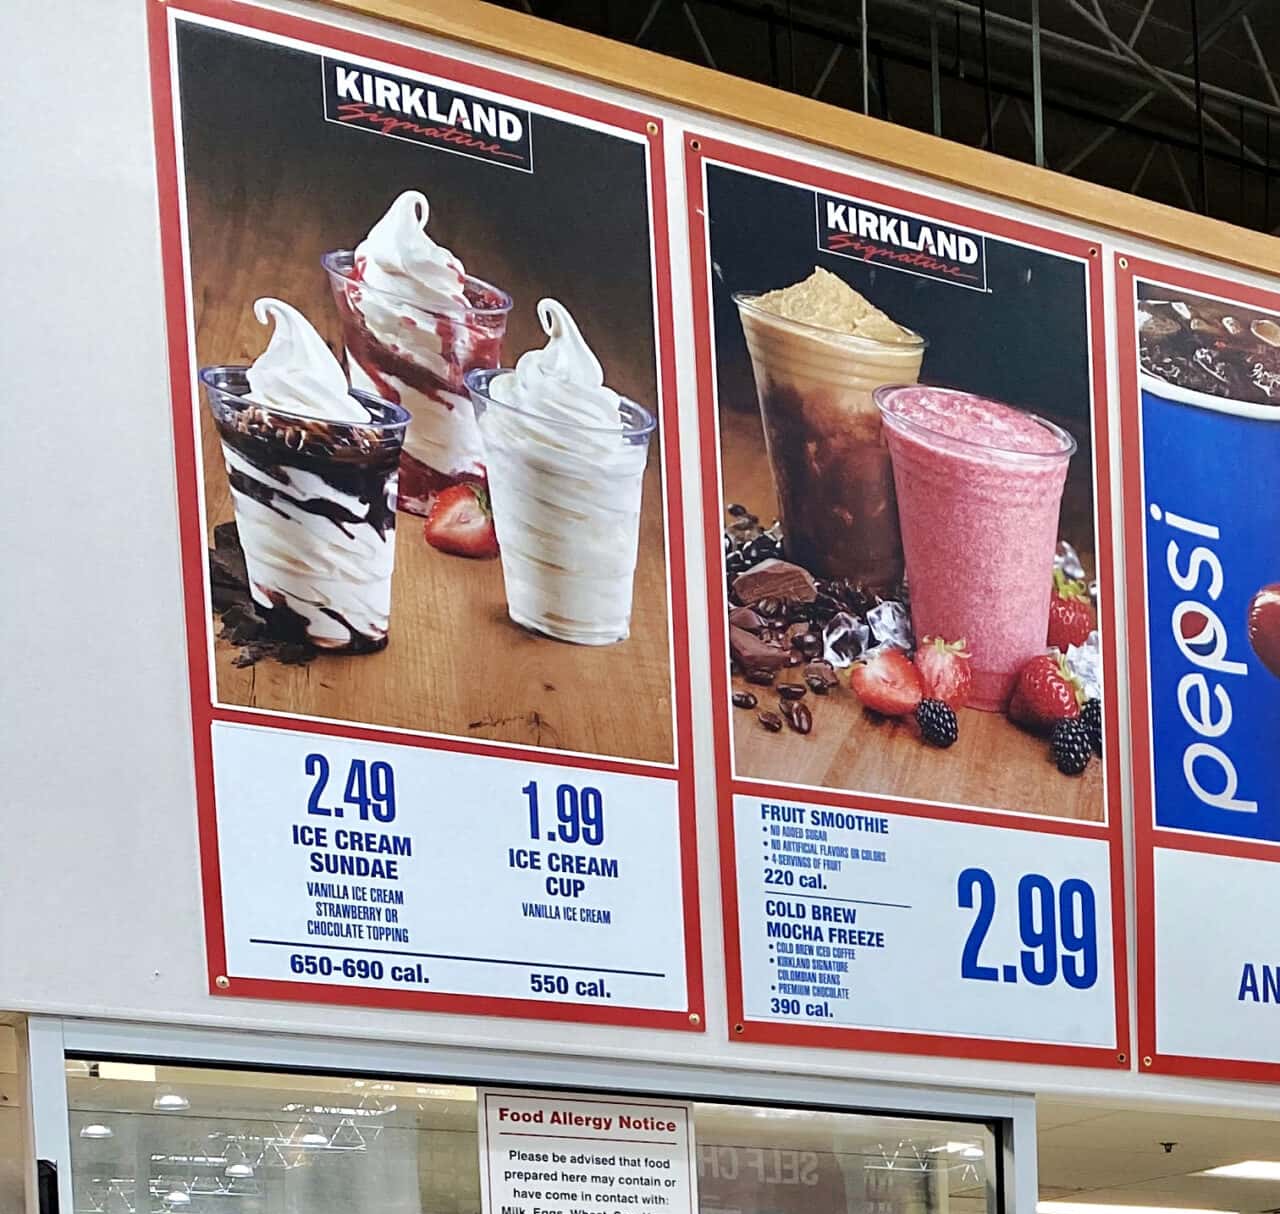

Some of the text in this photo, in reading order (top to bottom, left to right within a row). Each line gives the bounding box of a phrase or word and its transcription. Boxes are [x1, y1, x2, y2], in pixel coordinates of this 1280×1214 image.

[336, 66, 523, 142] KIRKLAND
[337, 103, 524, 159] Signature
[826, 200, 978, 264] KIRKLAND
[828, 233, 979, 281] Signature
[1149, 503, 1258, 814] pepsi
[305, 753, 397, 823] 2.49
[522, 781, 604, 846] 1.99
[761, 804, 889, 834] FRUIT SMOOTHIE
[292, 825, 412, 857] ICE CREAM
[820, 844, 848, 858] FLAVORS
[310, 853, 398, 880] SUNDAE
[508, 848, 619, 878] ICE CREAM
[545, 875, 585, 898] CUP
[764, 868, 827, 890] 220 cal.
[307, 882, 404, 905] VANILLA ICE CREAM
[316, 902, 398, 924] STRAWBERRY OR
[522, 902, 611, 925] VANILLA ICE CREAM
[766, 900, 856, 924] COLD BREW
[307, 921, 409, 944] CHOCOLATE TOPPING
[767, 921, 885, 948] MOCHA FREEZE
[957, 867, 1098, 989] 2.99
[776, 942, 856, 960] COLD BREW ICED COFFEE
[290, 954, 430, 984] 650-690 cal.
[777, 956, 848, 972] KIRKLAND SIGNATURE
[530, 974, 611, 998] 550 cal.
[771, 998, 833, 1018] 390 cal.
[499, 1107, 677, 1133] Food Allergy Notice
[509, 1151, 670, 1169] Please be advised that food
[504, 1169, 677, 1188] prepared here may contain or
[513, 1188, 542, 1200] have
[545, 1191, 578, 1202] come
[581, 1190, 592, 1202] in
[595, 1192, 639, 1205] contact
